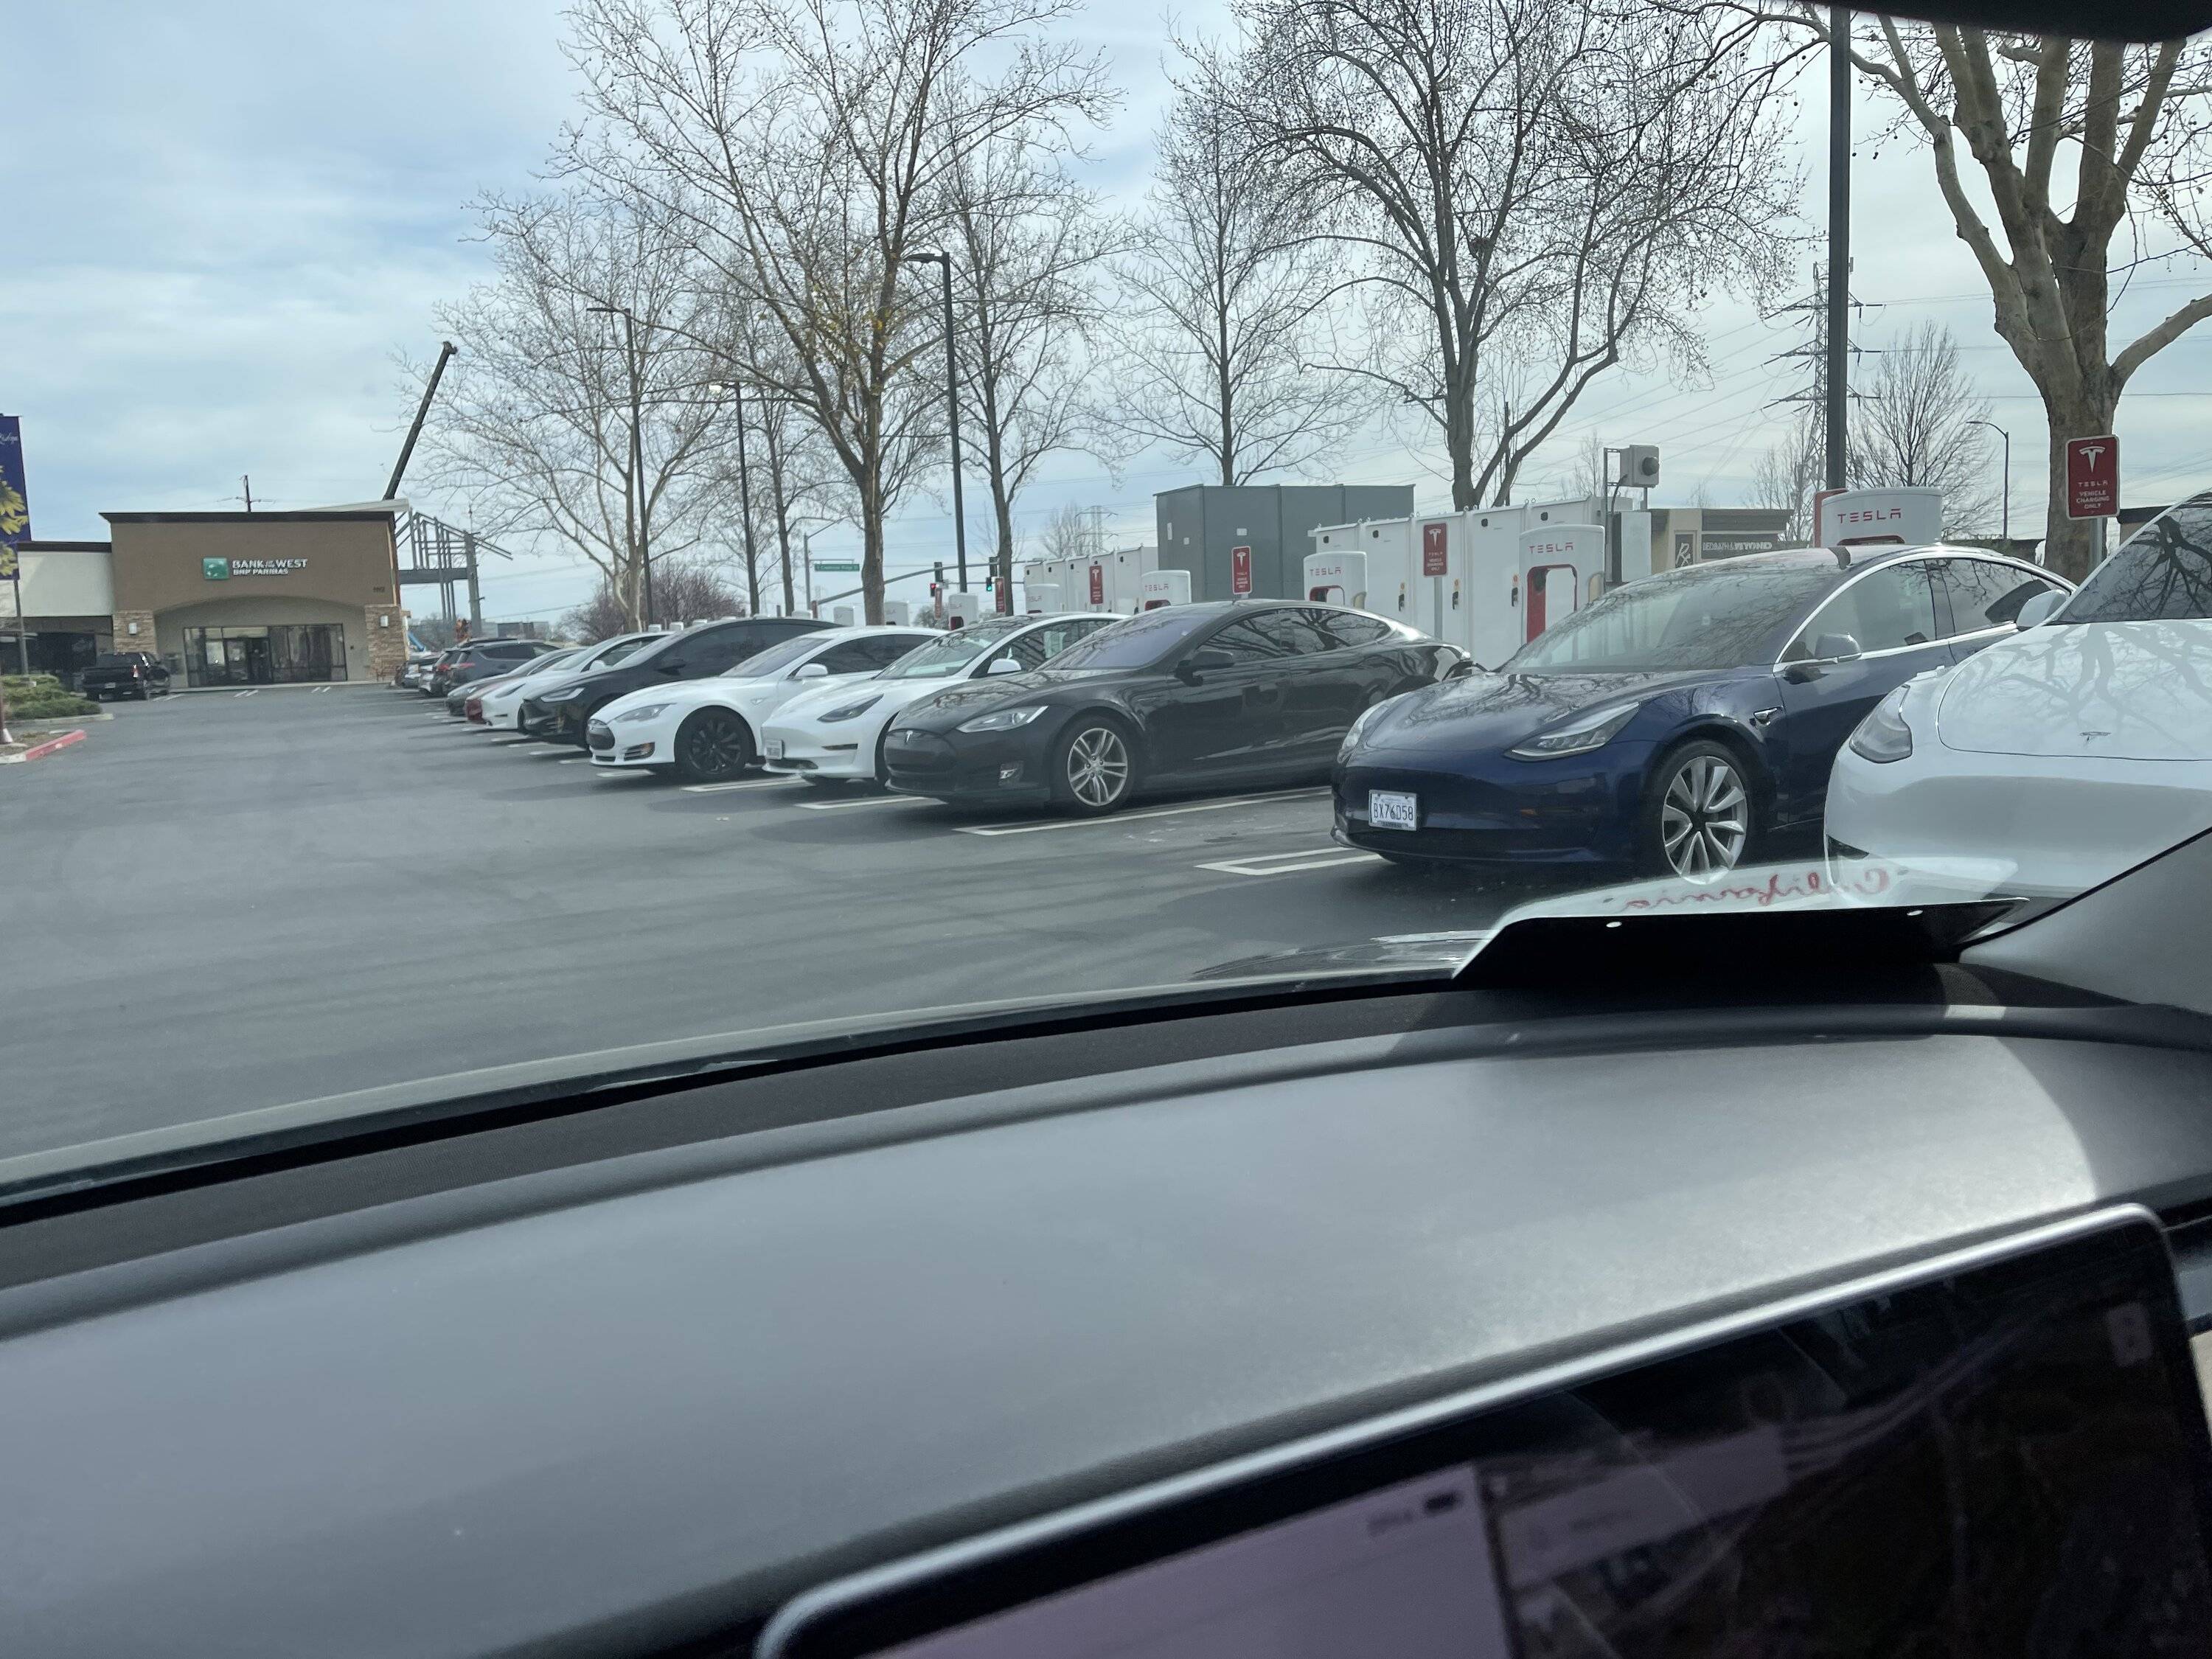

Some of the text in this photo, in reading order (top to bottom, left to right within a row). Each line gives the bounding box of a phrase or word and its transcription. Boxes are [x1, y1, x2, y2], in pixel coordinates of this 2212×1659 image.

[2076, 495, 2110, 504] CHARGING
[1837, 508, 1902, 524] TESLA
[1529, 542, 1574, 554] TESLA
[232, 560, 265, 569] BANK
[275, 558, 308, 568] WEST
[1310, 567, 1342, 577] TESLA
